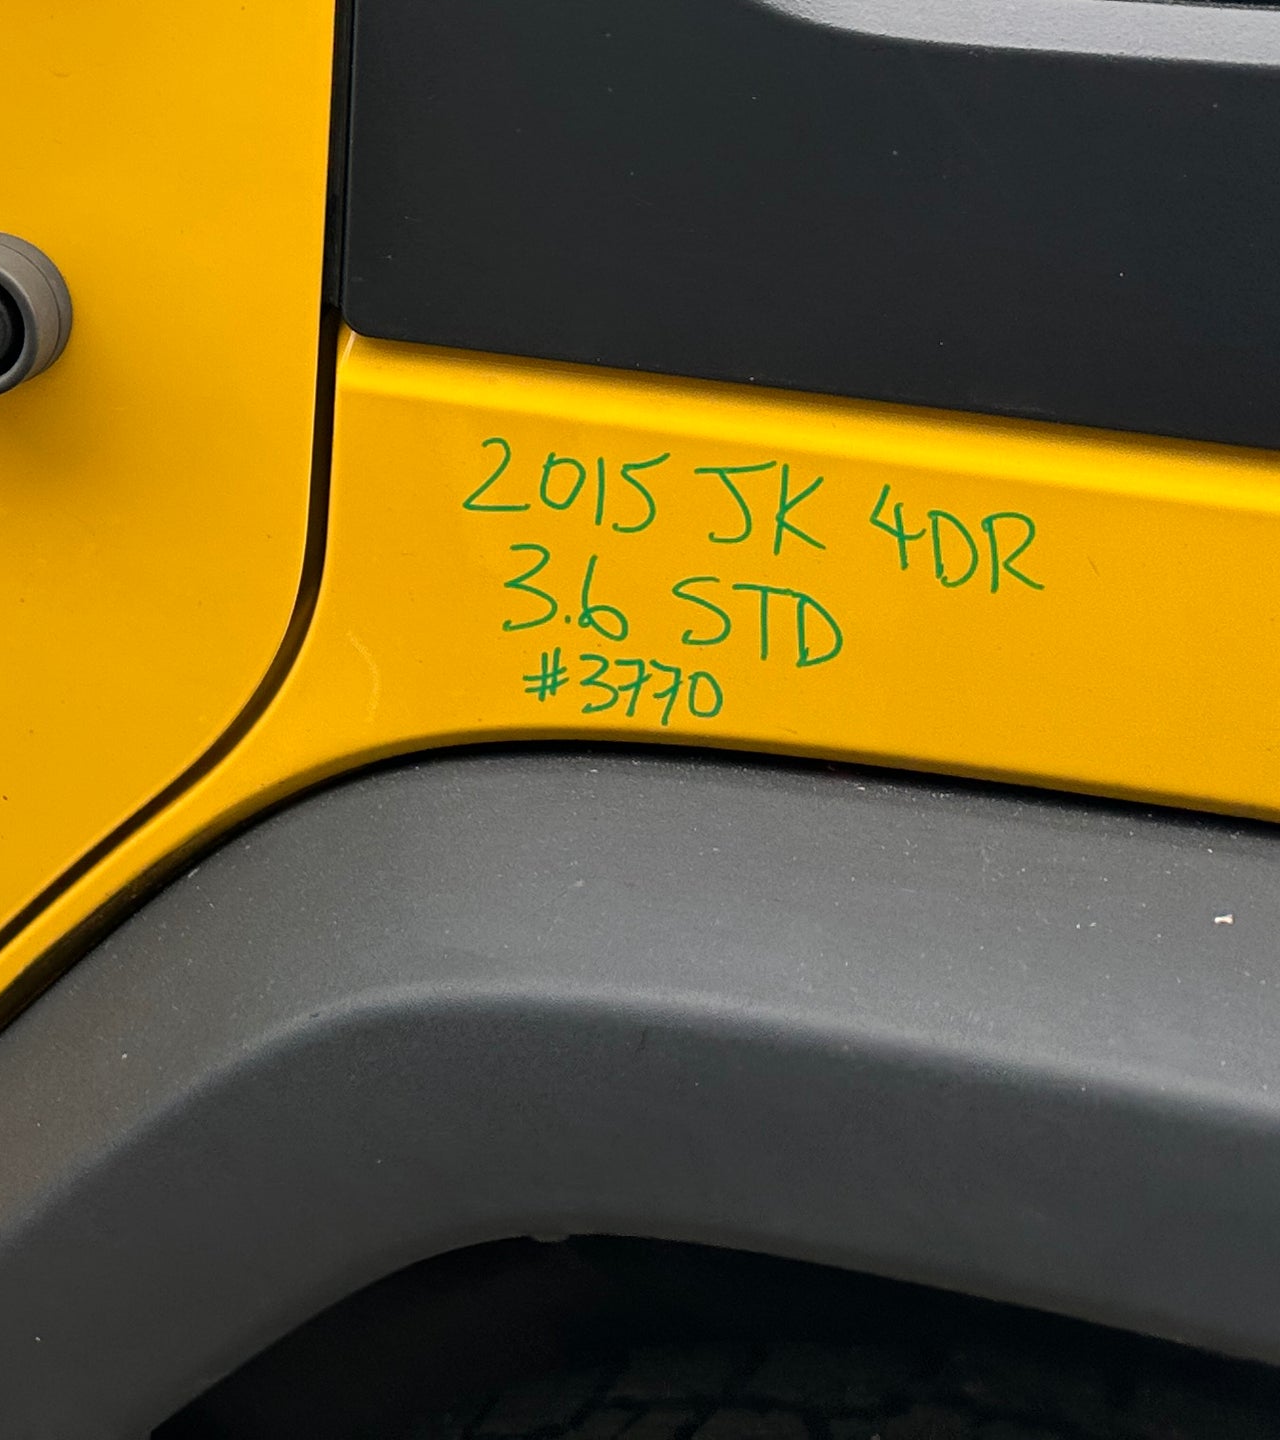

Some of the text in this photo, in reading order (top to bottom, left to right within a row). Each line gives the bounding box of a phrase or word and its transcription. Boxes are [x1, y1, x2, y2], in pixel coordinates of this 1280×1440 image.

[462, 436, 1046, 594] 2015 JK 4DR
[501, 542, 844, 668] 3.6 STD
[522, 646, 724, 727] #3770
